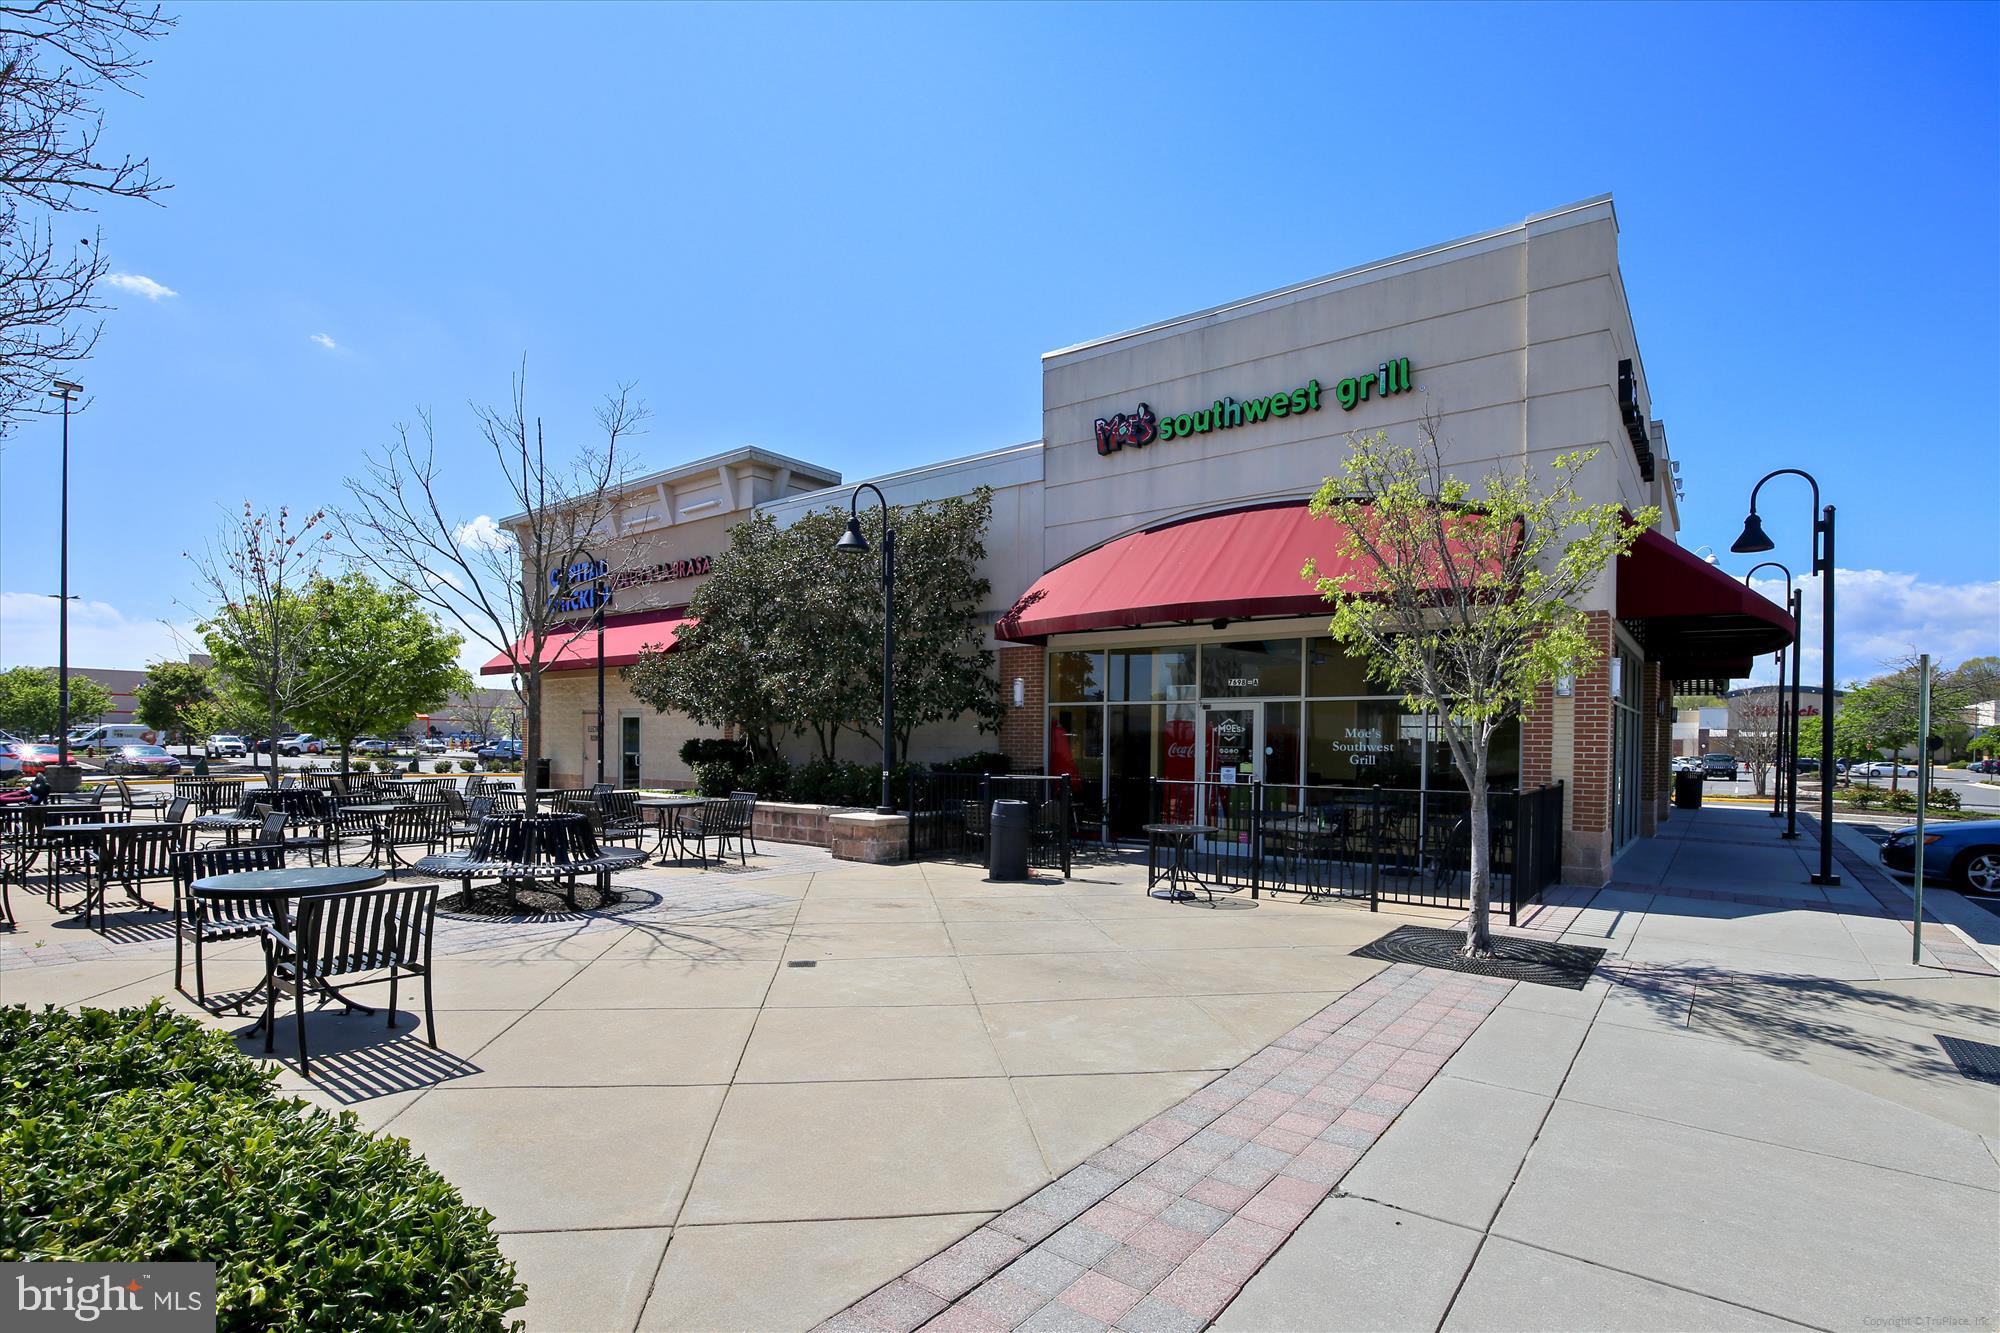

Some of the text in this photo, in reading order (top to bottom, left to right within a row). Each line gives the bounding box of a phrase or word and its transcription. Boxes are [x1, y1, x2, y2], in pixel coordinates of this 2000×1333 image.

[1159, 379, 1321, 442] southwest
[1336, 357, 1413, 411] grill
[671, 556, 712, 578] BRASA
[1344, 728, 1382, 738] Moe's
[1332, 741, 1394, 752] Southwest
[1349, 755, 1376, 765] Grill
